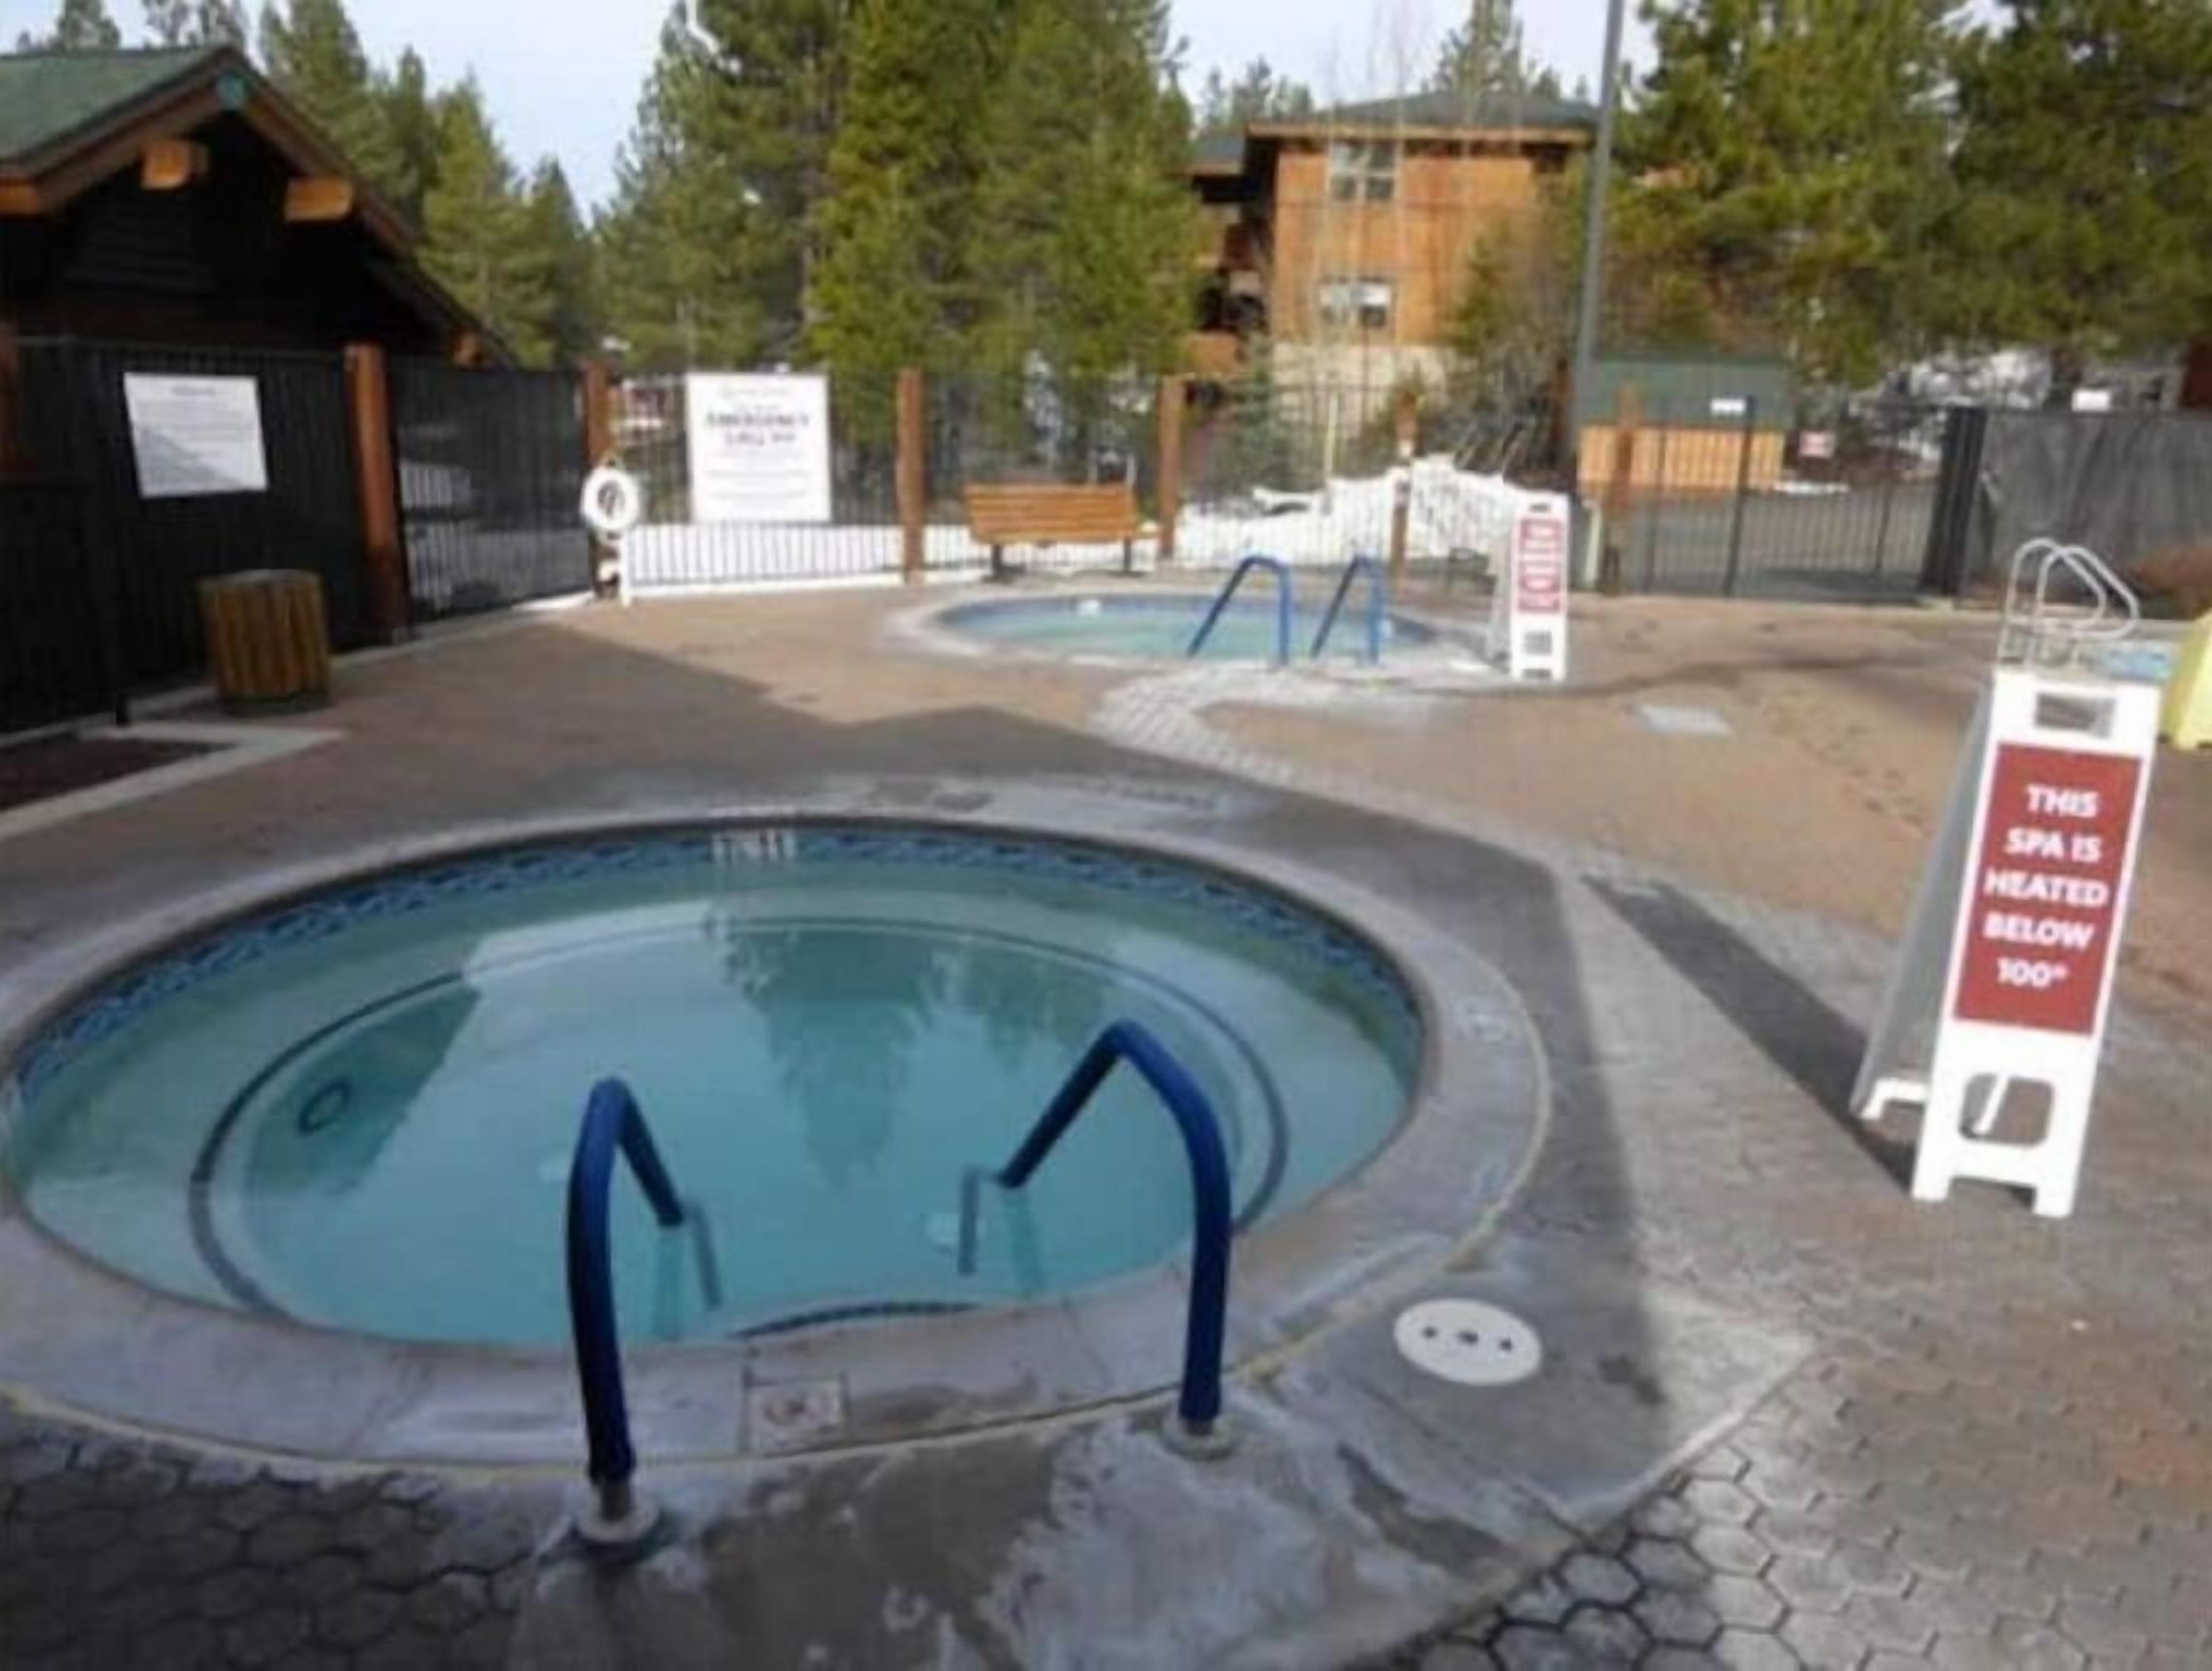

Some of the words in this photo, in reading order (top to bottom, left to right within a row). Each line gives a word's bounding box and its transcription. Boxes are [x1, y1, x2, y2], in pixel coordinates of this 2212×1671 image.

[2026, 784, 2099, 818] THIS
[2003, 827, 2065, 859] SPA
[2071, 834, 2103, 863] IS
[1983, 869, 2110, 907] HEATED
[1983, 911, 2095, 952] BELOW
